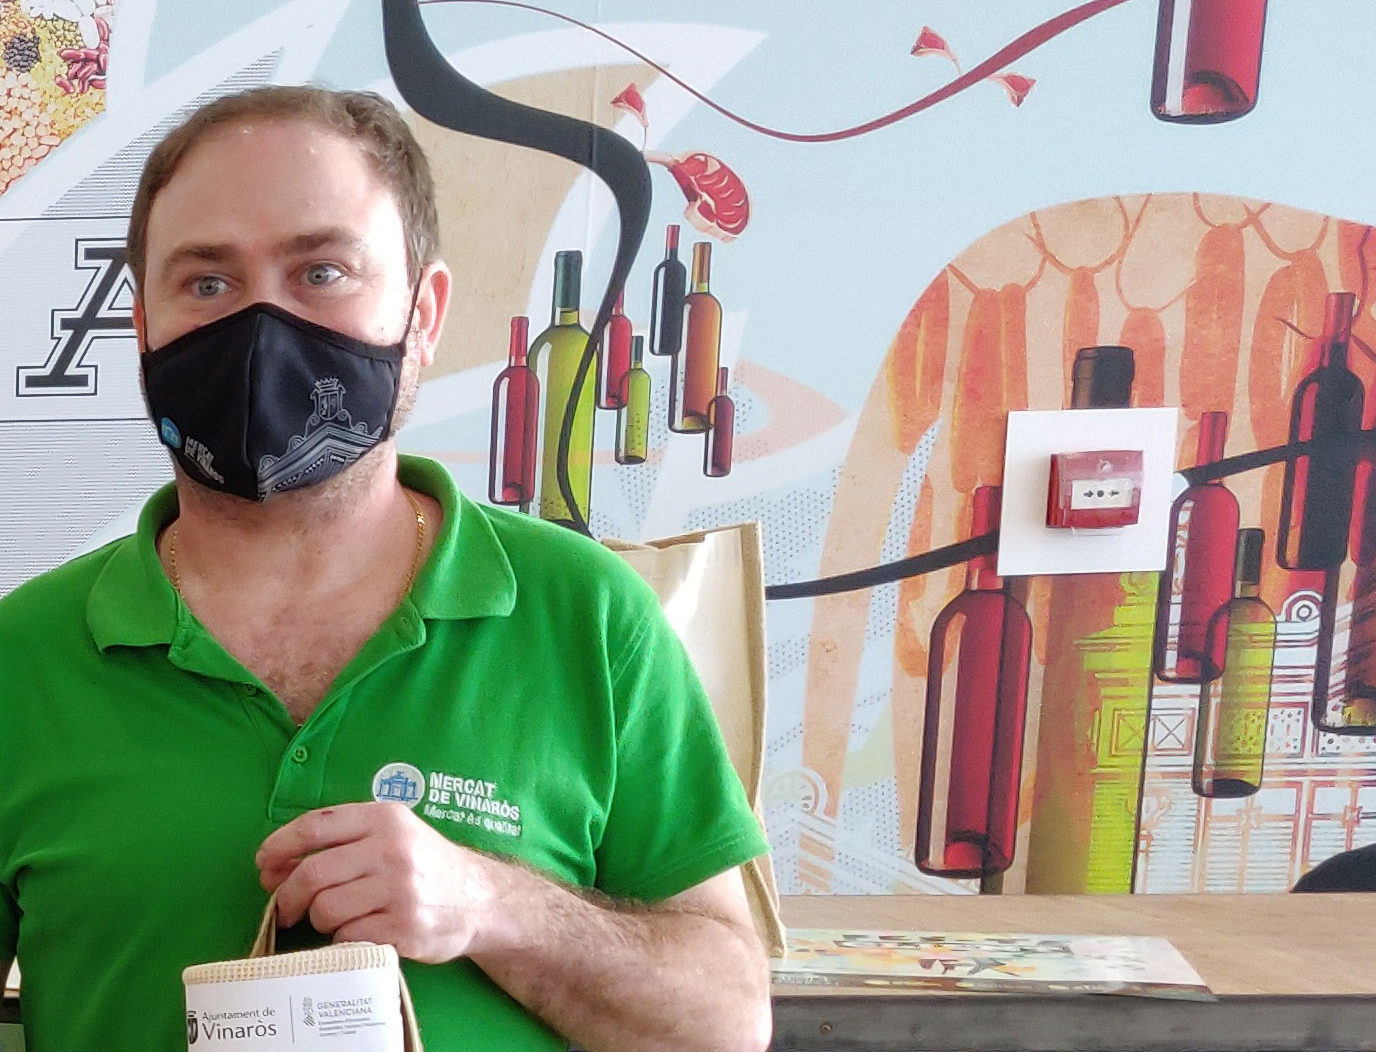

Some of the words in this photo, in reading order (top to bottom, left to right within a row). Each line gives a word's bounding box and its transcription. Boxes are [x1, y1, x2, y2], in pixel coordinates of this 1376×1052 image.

[429, 771, 496, 798] MERCAT
[428, 788, 451, 805] DE
[455, 792, 520, 821] VINARÒS
[202, 1009, 261, 1021] Ajuntament
[263, 1008, 276, 1018] de
[202, 1020, 277, 1040] Vinaròs
